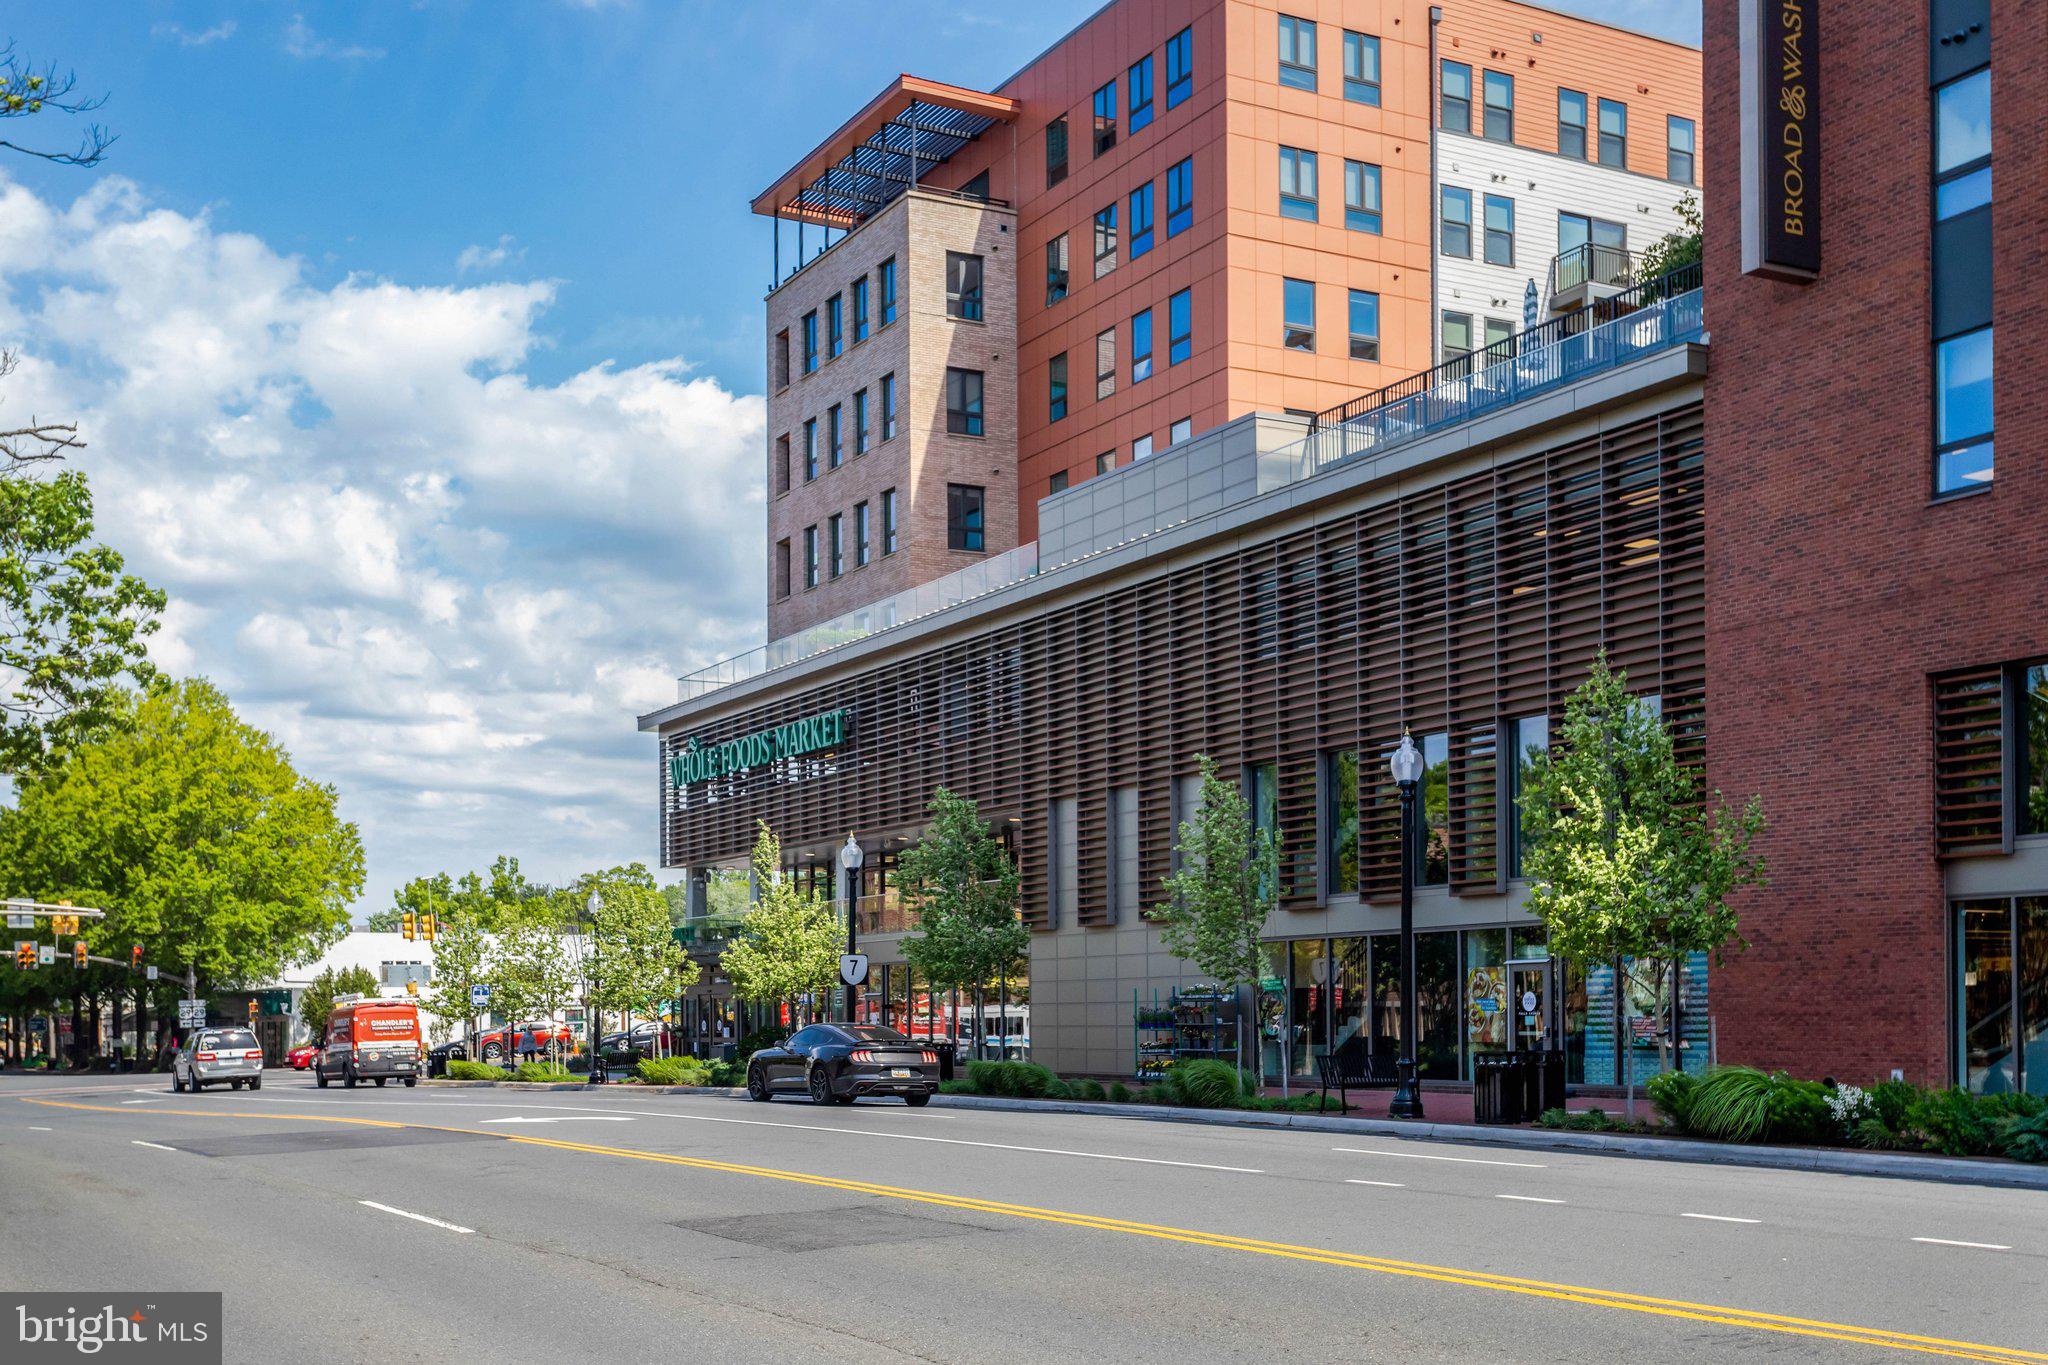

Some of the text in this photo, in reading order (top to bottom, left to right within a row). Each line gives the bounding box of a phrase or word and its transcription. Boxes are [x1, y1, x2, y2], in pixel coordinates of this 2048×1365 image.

[1780, 86, 1806, 120] &
[1784, 122, 1803, 236] BROAD
[670, 711, 843, 787] WHOLE FOODS MARKET
[849, 959, 858, 976] 7
[180, 1008, 191, 1017] 29
[194, 1008, 204, 1017] 29
